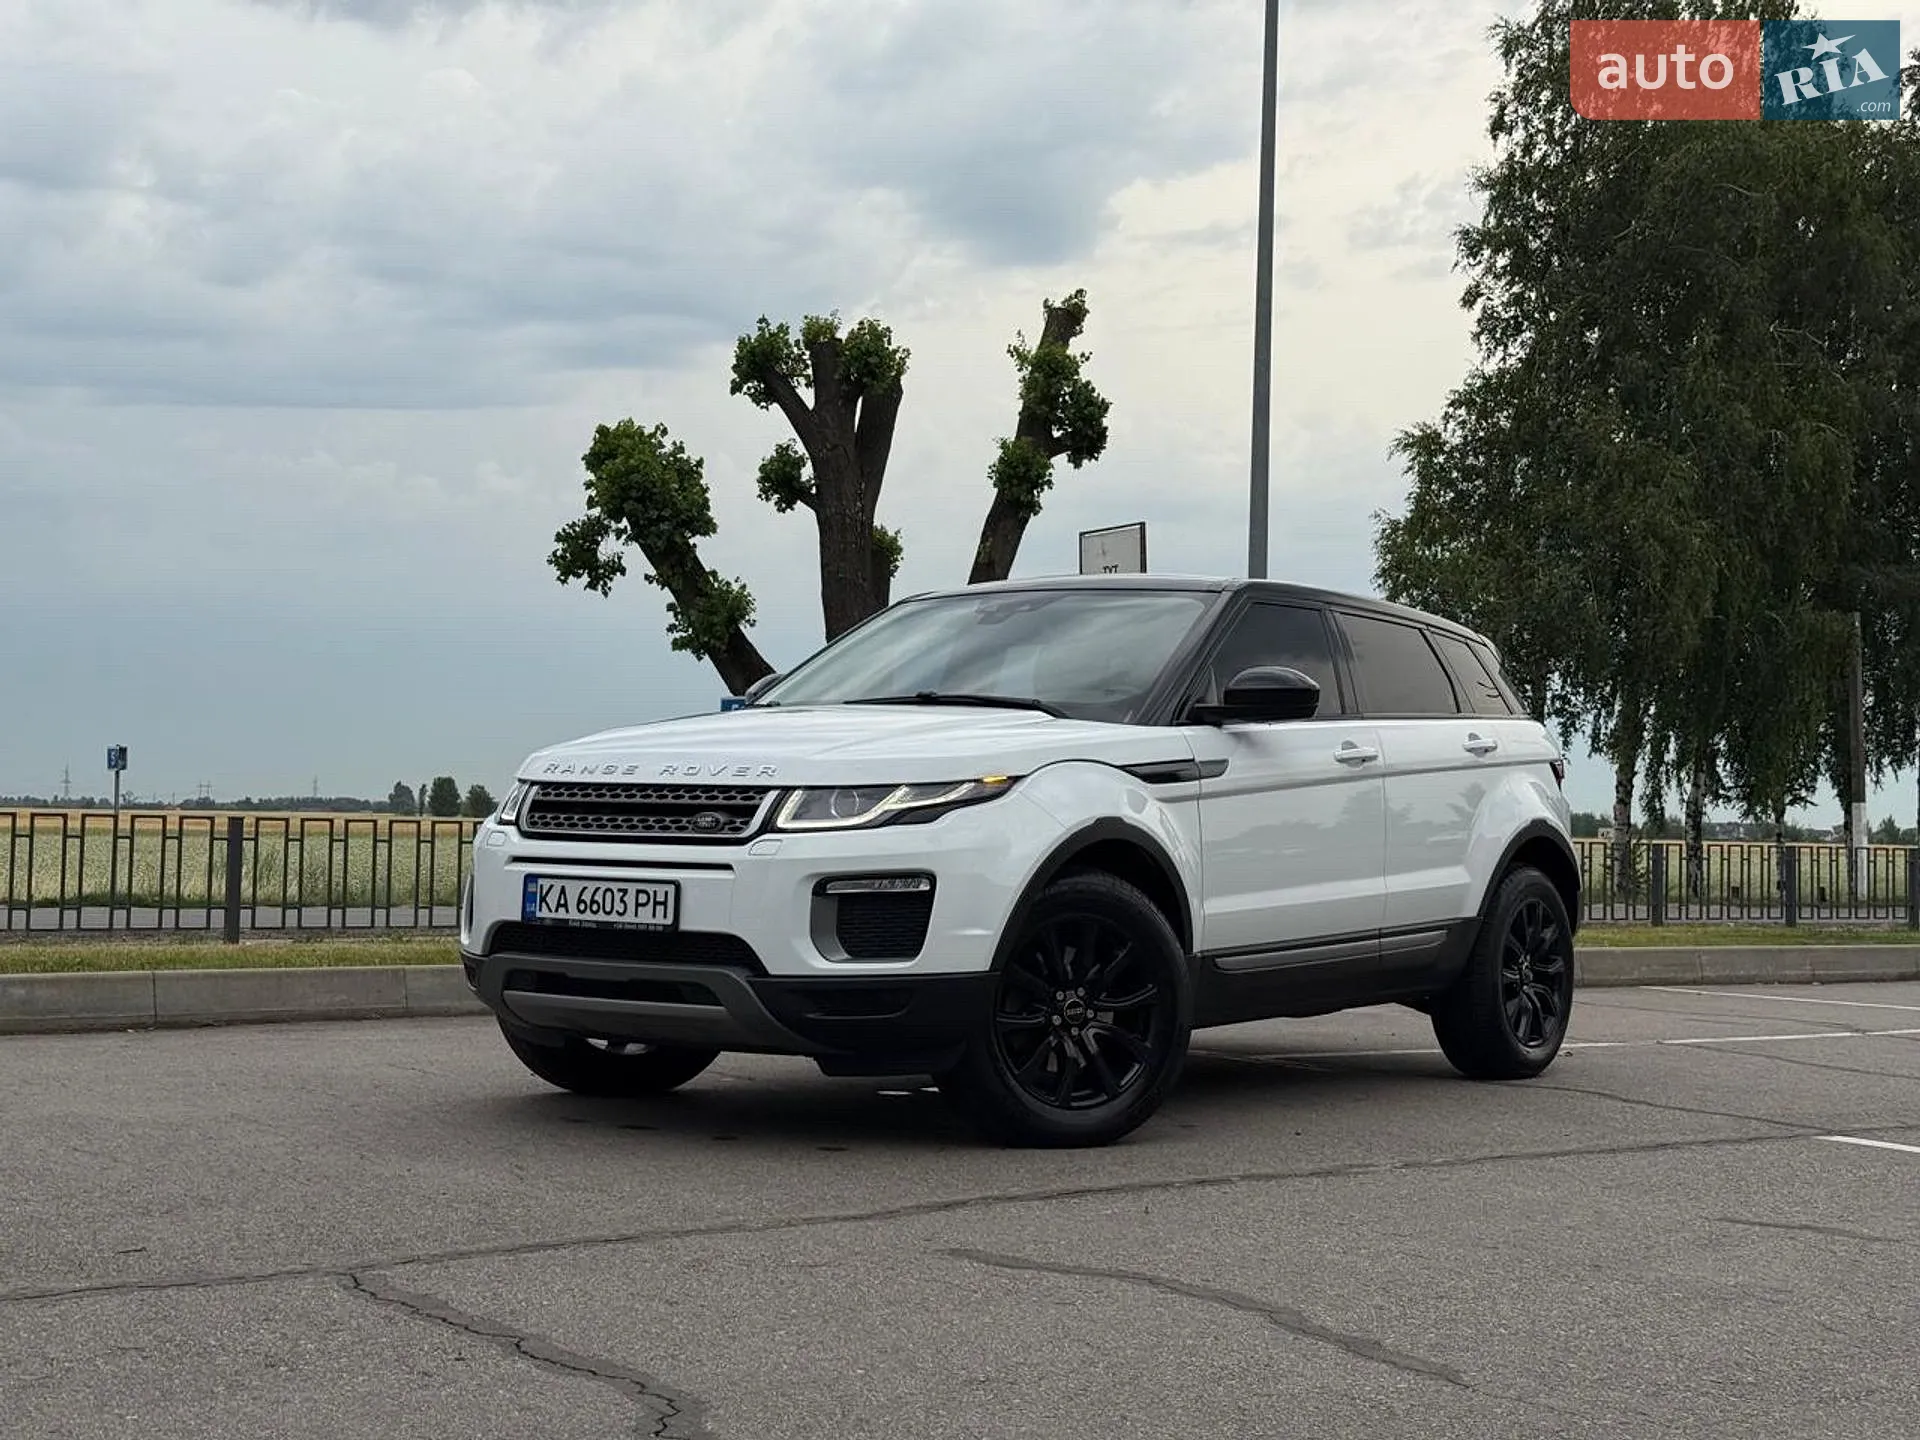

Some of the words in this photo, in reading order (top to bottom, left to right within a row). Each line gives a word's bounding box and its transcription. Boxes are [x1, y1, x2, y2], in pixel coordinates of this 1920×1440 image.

[543, 763, 640, 776] RANGE
[658, 765, 779, 778] ROVER
[538, 884, 569, 914] KA
[576, 886, 628, 916] 6603
[634, 889, 669, 919] PH
